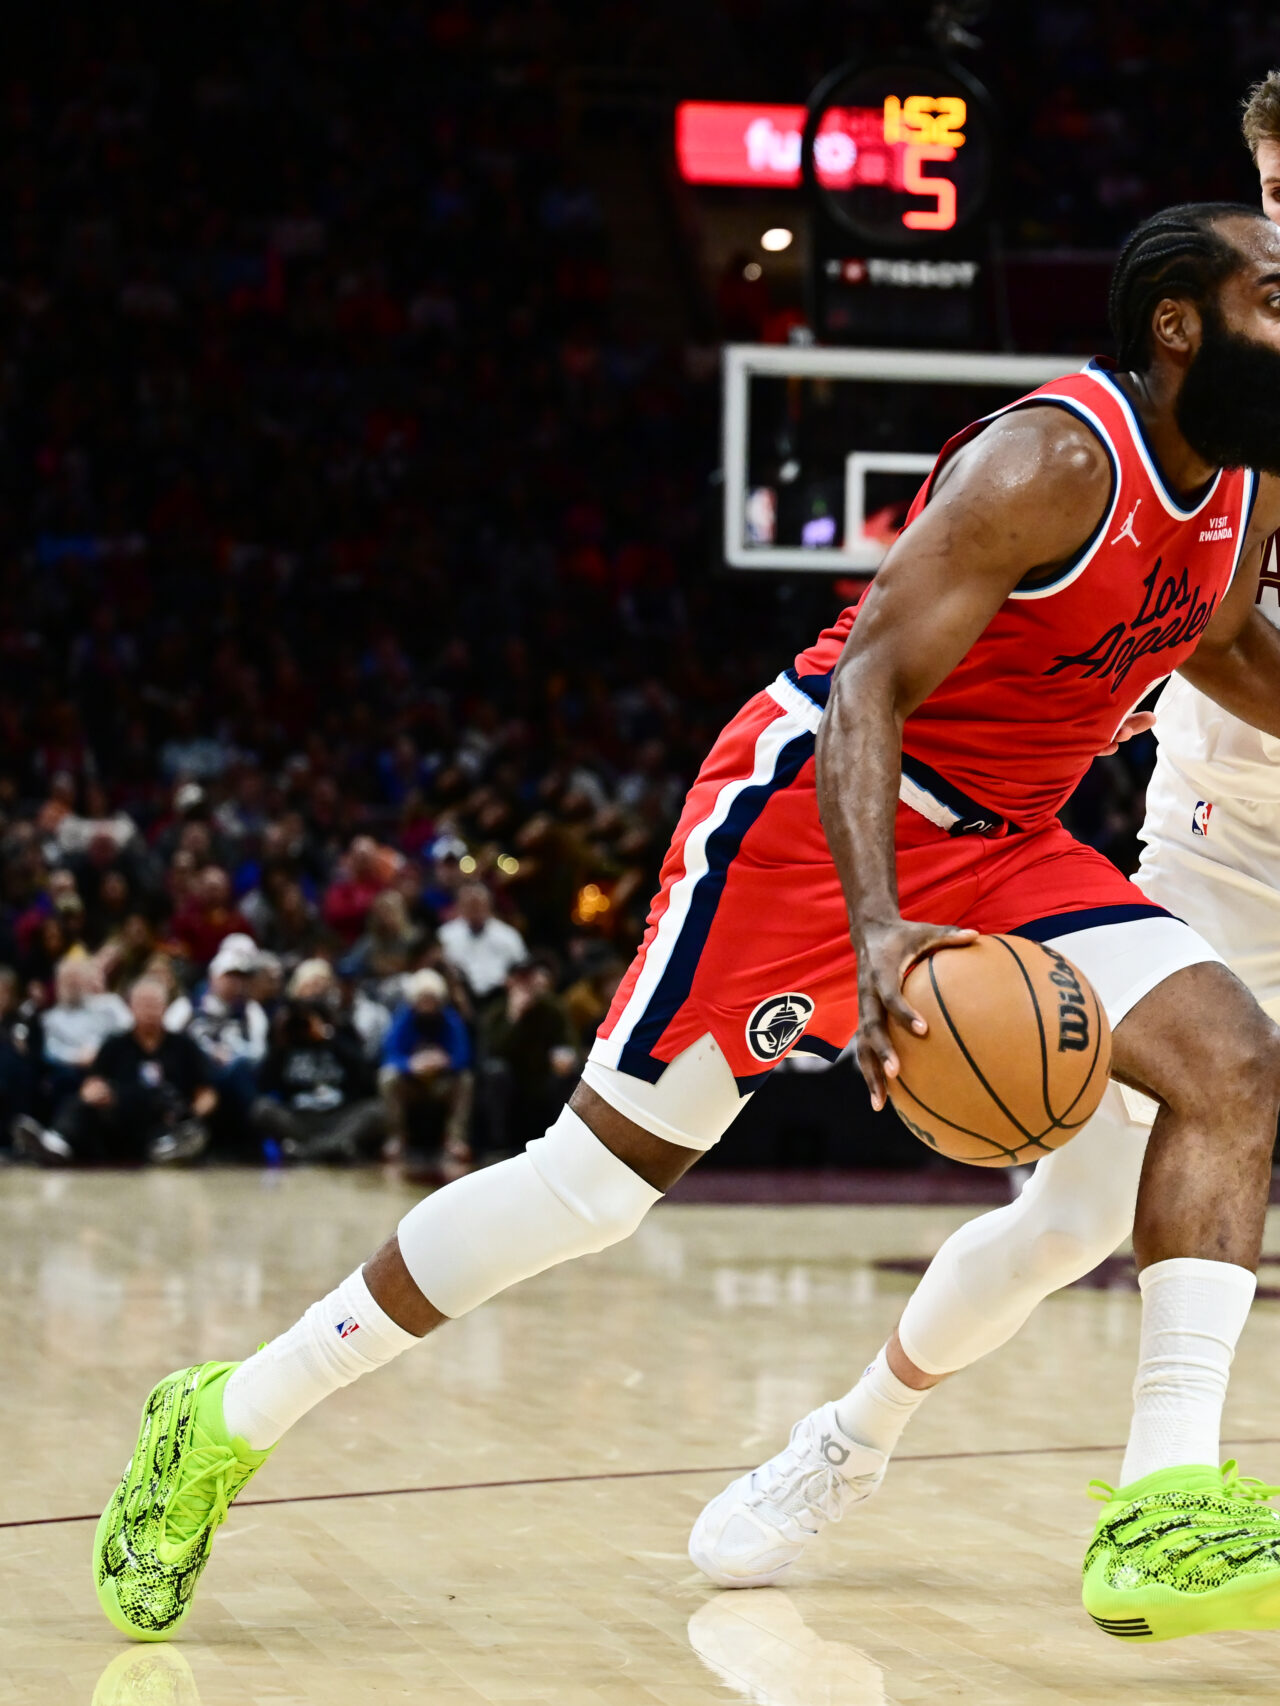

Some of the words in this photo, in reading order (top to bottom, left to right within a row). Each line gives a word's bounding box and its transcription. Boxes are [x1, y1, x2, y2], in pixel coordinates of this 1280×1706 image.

[743, 117, 857, 173] fuo
[903, 143, 956, 230] 5
[1199, 527, 1233, 542] RWANDA
[1209, 515, 1228, 529] VISIT
[1130, 555, 1191, 630] Los
[1041, 585, 1218, 695] Angeles
